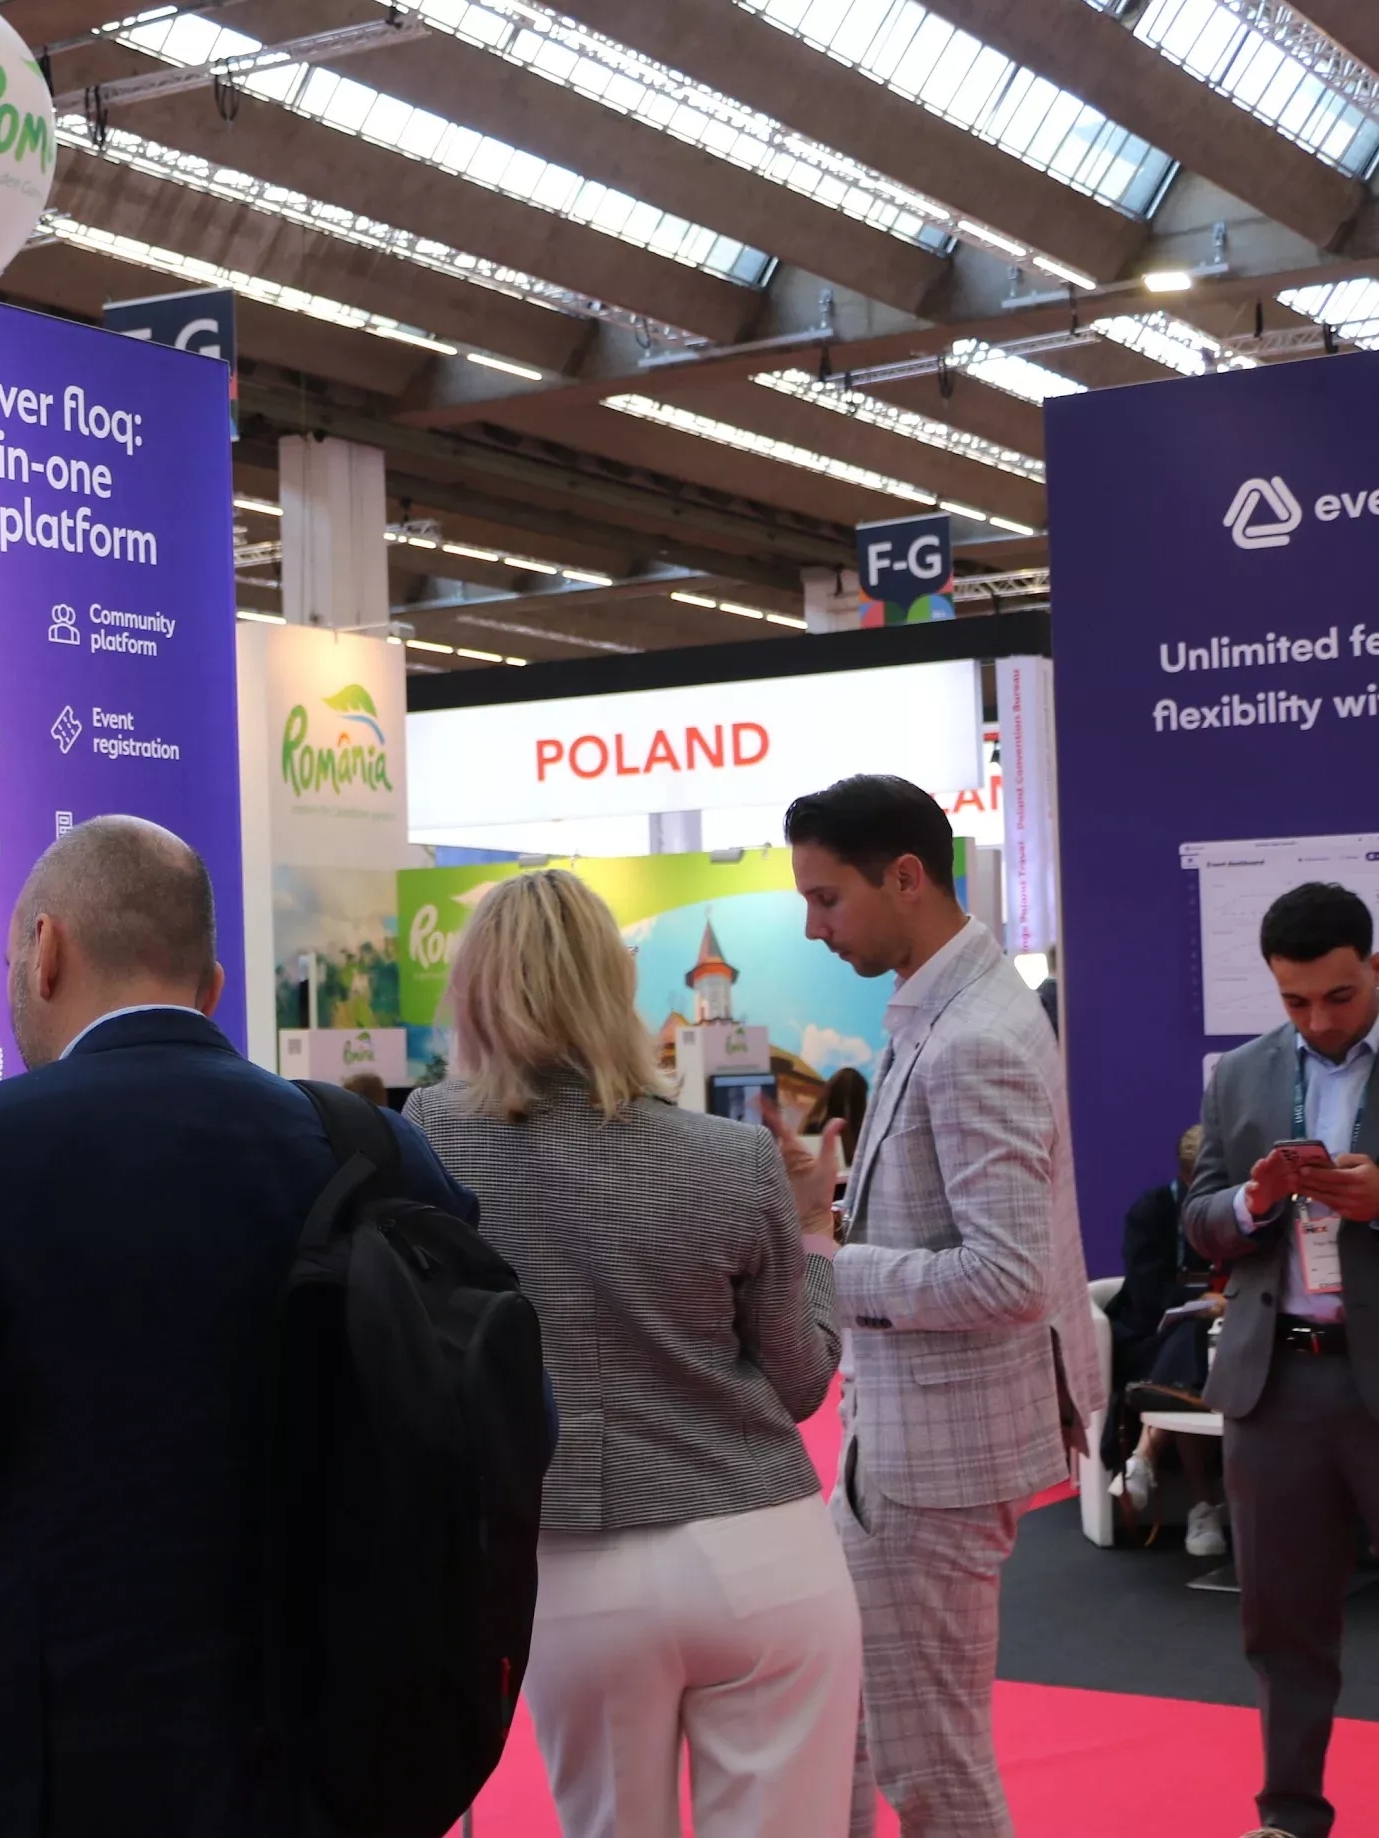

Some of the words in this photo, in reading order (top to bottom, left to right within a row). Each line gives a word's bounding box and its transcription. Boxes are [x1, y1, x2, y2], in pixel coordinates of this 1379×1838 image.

[63, 385, 143, 456] floq:
[0, 496, 159, 566] platform
[868, 534, 943, 588] F-G
[89, 603, 177, 638] Community
[91, 628, 158, 658] platform
[1159, 625, 1340, 674] Unlimited
[92, 707, 135, 731] Event
[1152, 690, 1323, 733] flexibility
[1332, 683, 1379, 719] wi
[93, 734, 181, 761] registration
[536, 721, 770, 782] POLAND
